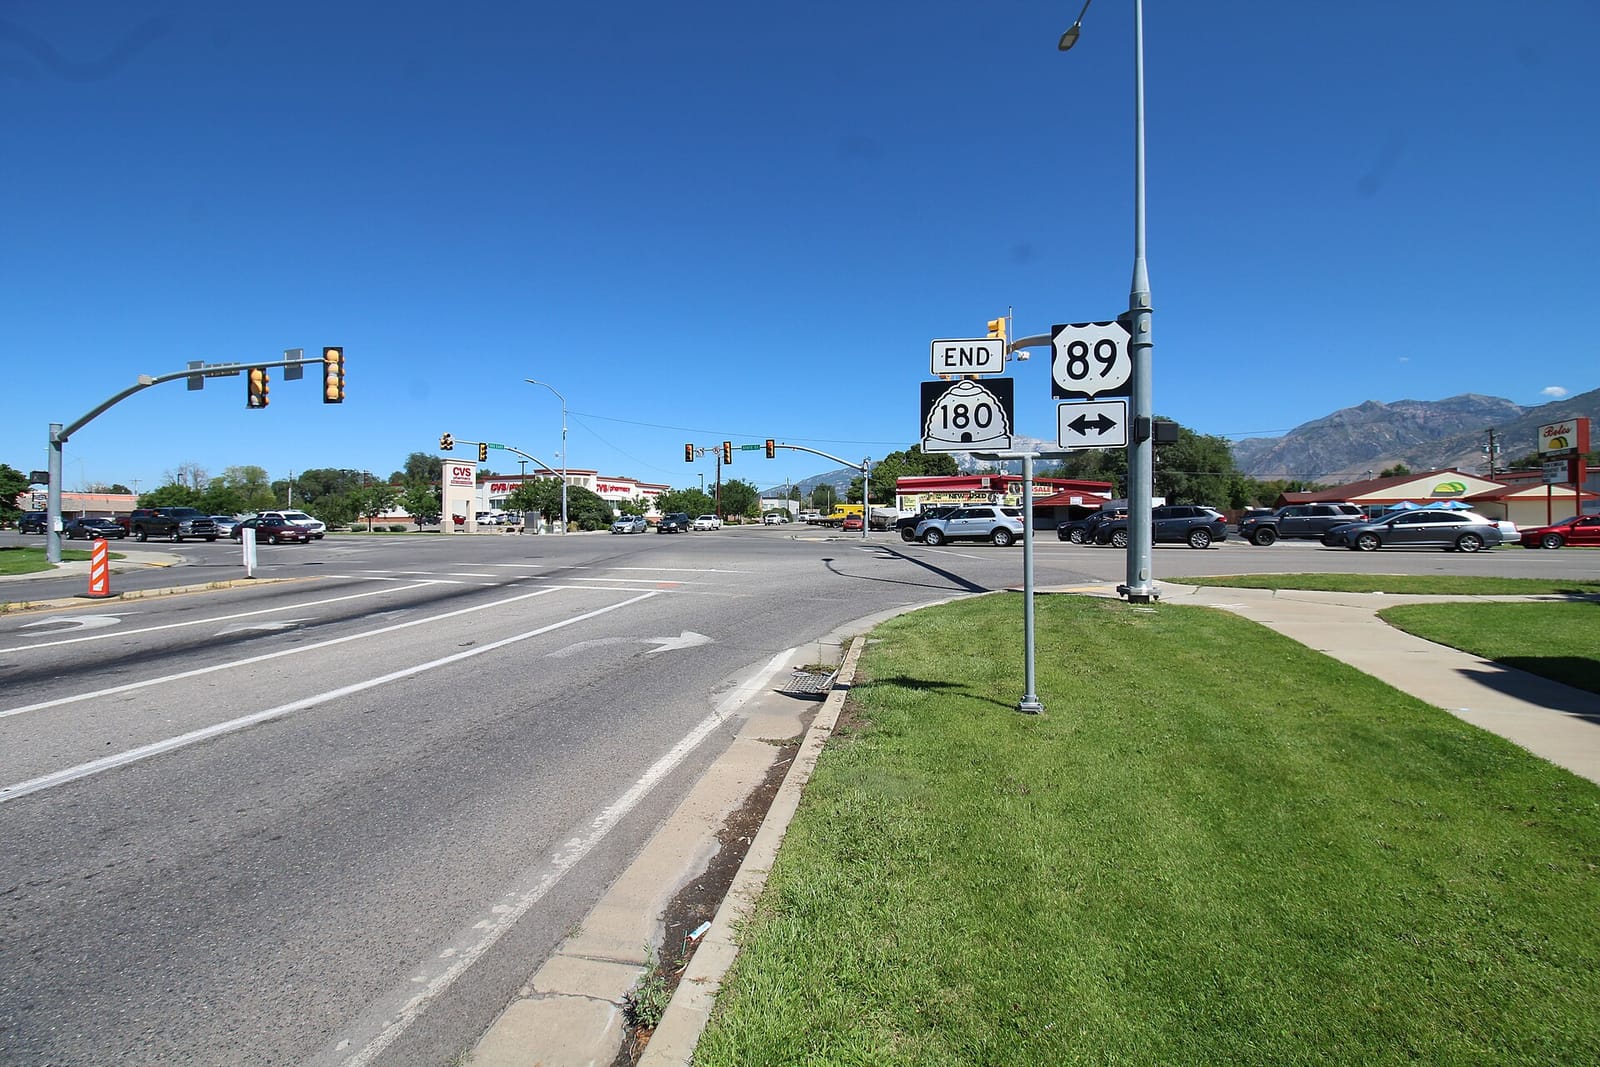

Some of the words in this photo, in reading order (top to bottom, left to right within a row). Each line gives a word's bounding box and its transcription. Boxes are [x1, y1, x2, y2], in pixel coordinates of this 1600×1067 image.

[944, 347, 990, 367] END
[1066, 338, 1117, 380] 89
[940, 402, 992, 429] 180
[453, 466, 471, 477] CVS
